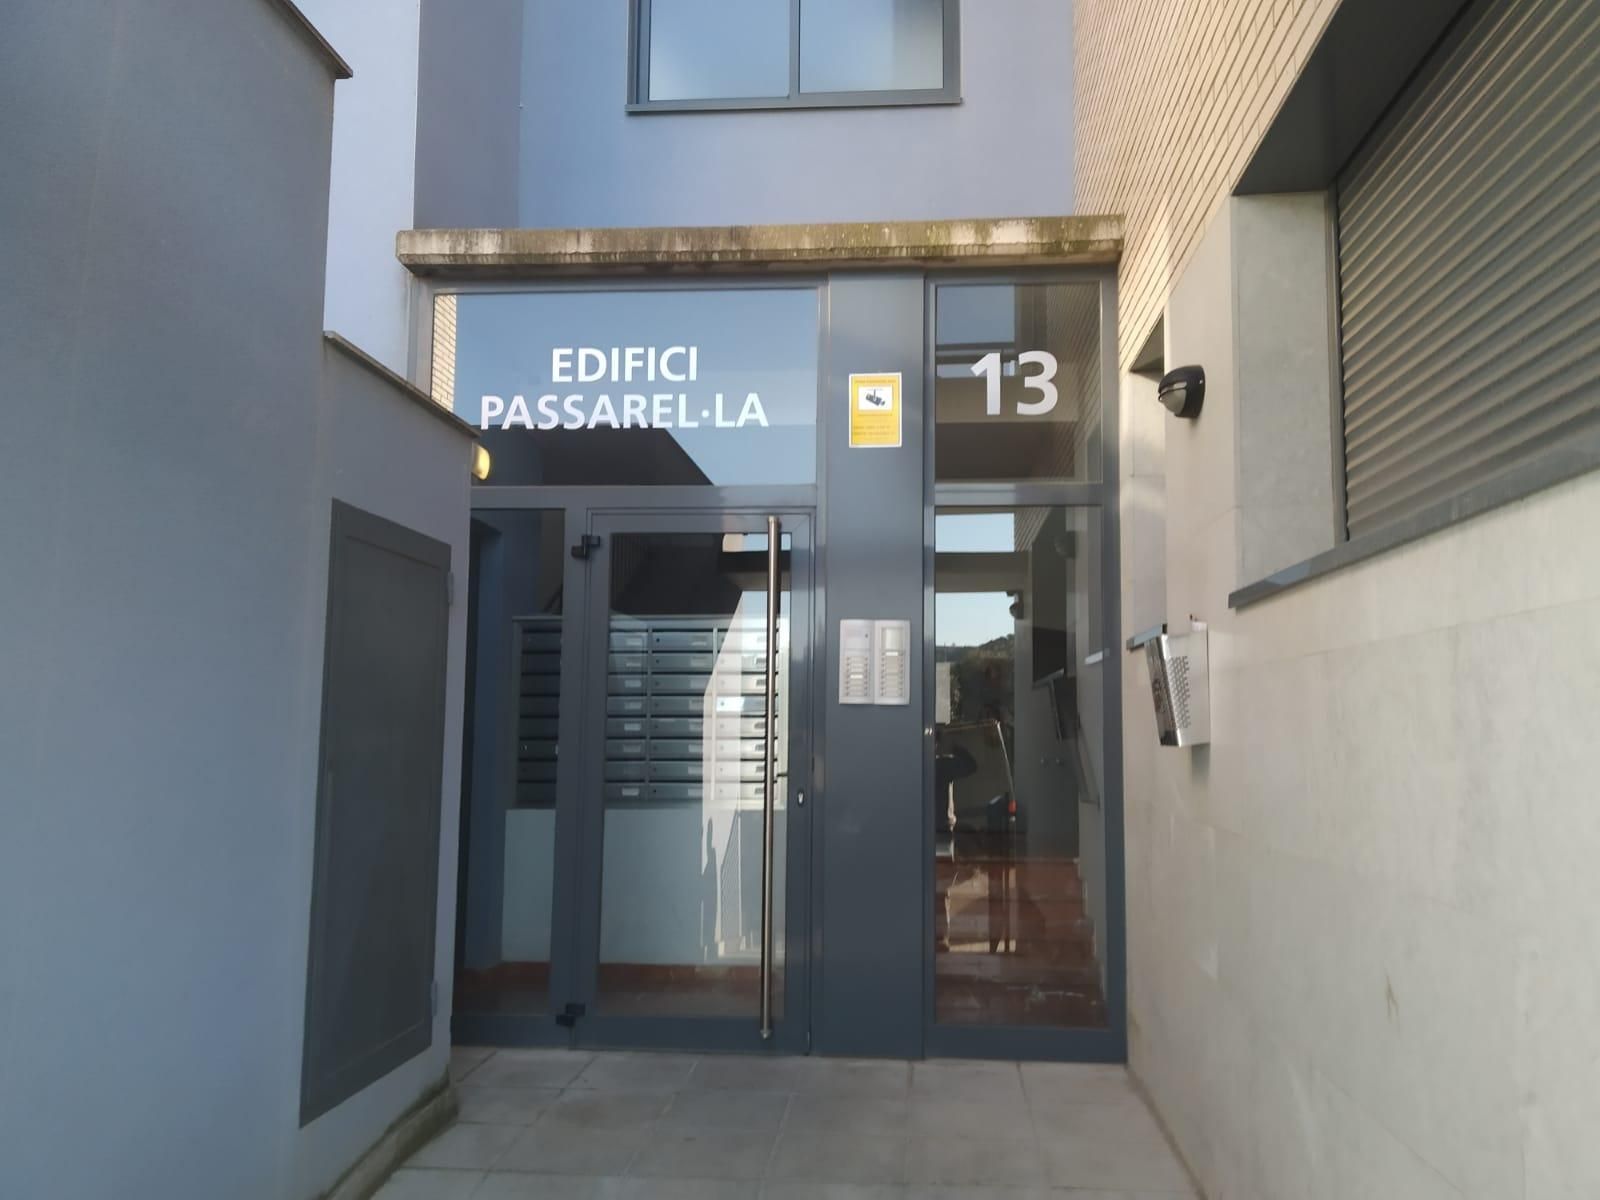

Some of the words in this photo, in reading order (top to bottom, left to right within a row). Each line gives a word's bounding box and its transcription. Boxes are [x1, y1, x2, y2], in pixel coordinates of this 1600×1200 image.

[552, 346, 698, 383] EDIFICI
[970, 350, 1058, 416] 13
[480, 392, 769, 430] PASSAREL·LA
